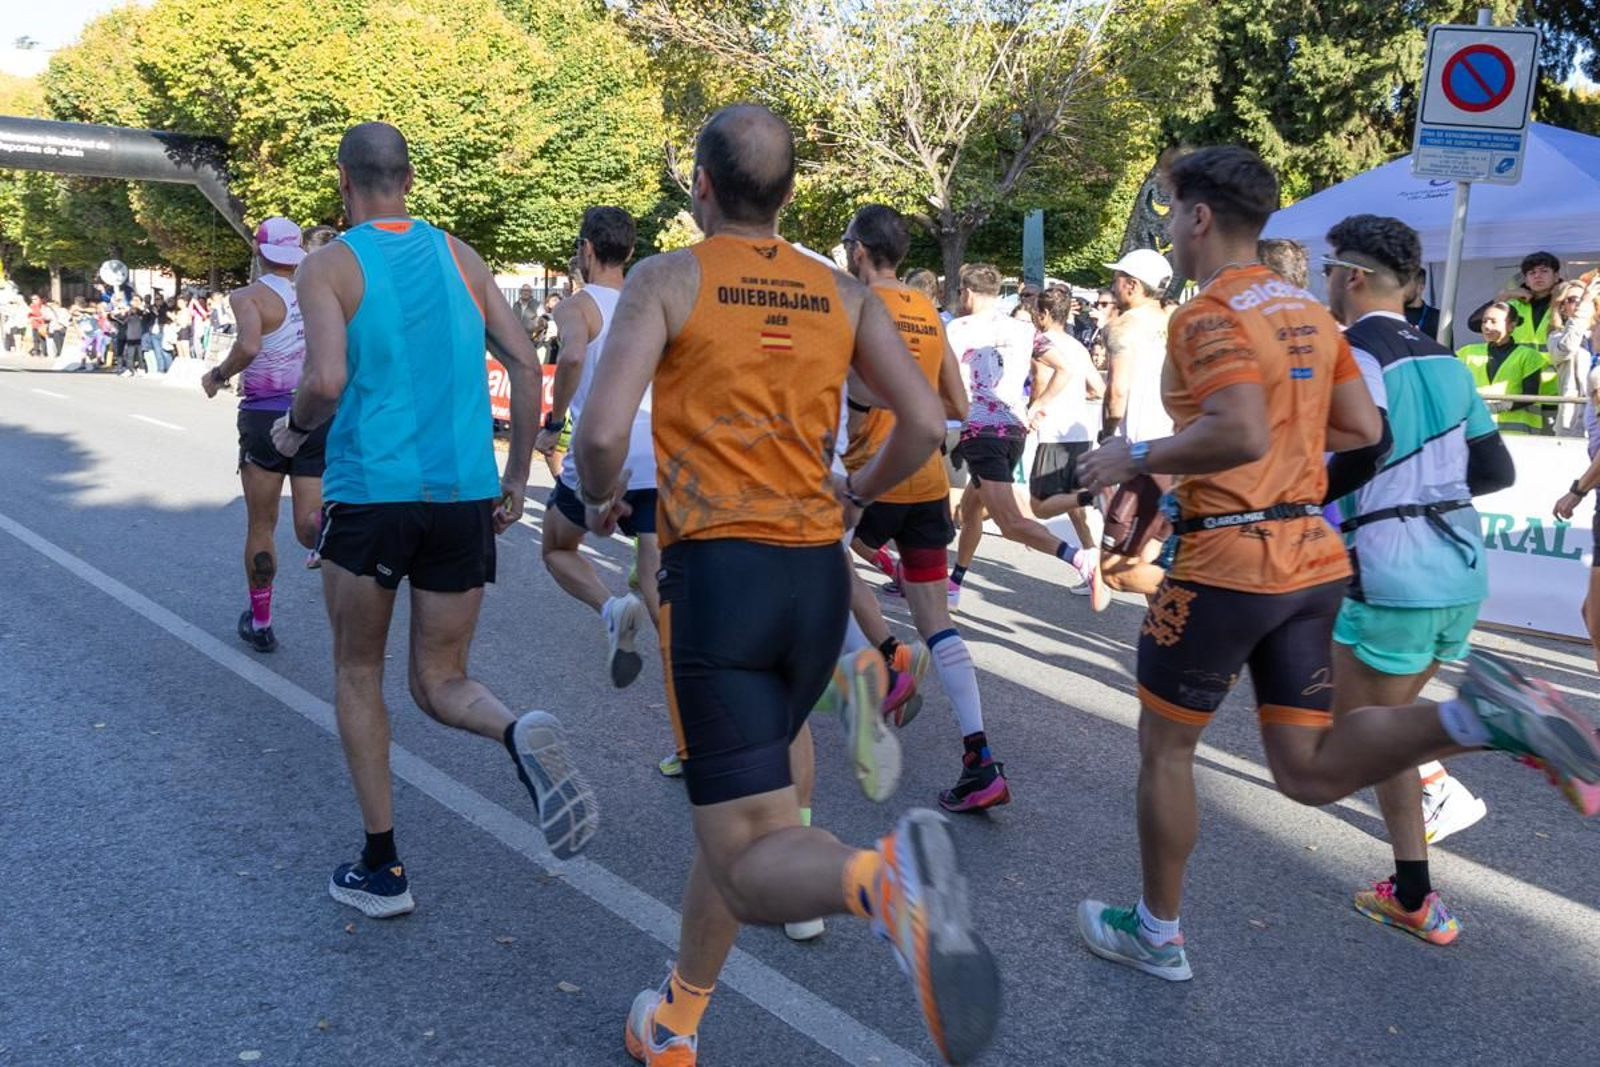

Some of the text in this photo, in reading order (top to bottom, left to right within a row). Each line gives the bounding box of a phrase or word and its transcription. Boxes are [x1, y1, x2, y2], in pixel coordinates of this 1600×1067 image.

[718, 286, 831, 314] QUIEBRAJANO
[765, 313, 788, 326] JAÉN
[1480, 511, 1583, 561] RAL
